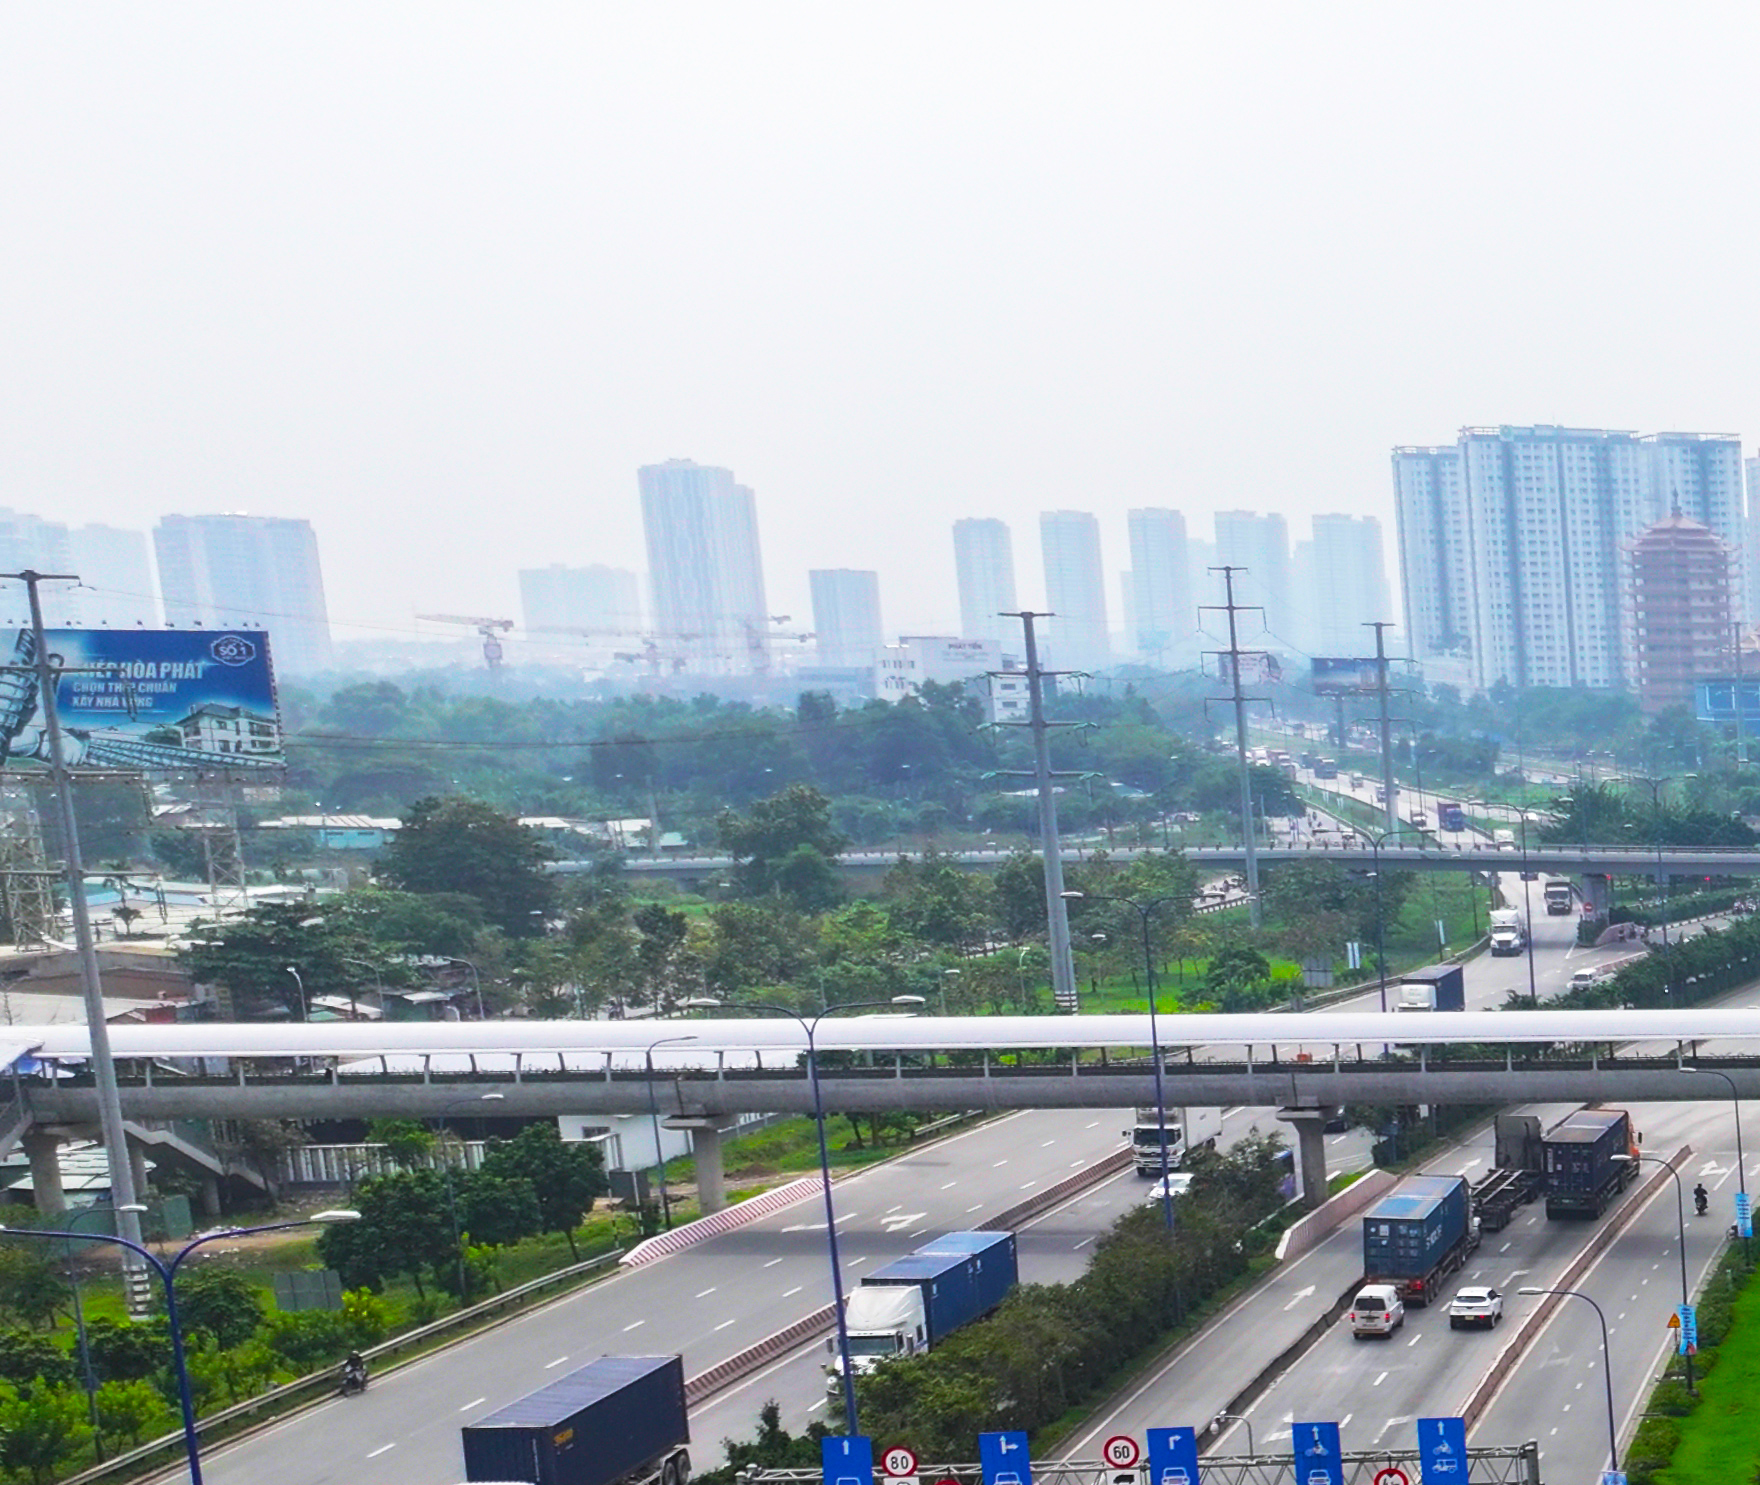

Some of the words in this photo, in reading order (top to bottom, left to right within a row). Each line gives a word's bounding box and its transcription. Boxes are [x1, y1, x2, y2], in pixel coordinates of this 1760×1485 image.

[160, 660, 204, 680] PHÁT
[1113, 1445, 1129, 1459] 60
[890, 1455, 908, 1469] 80
